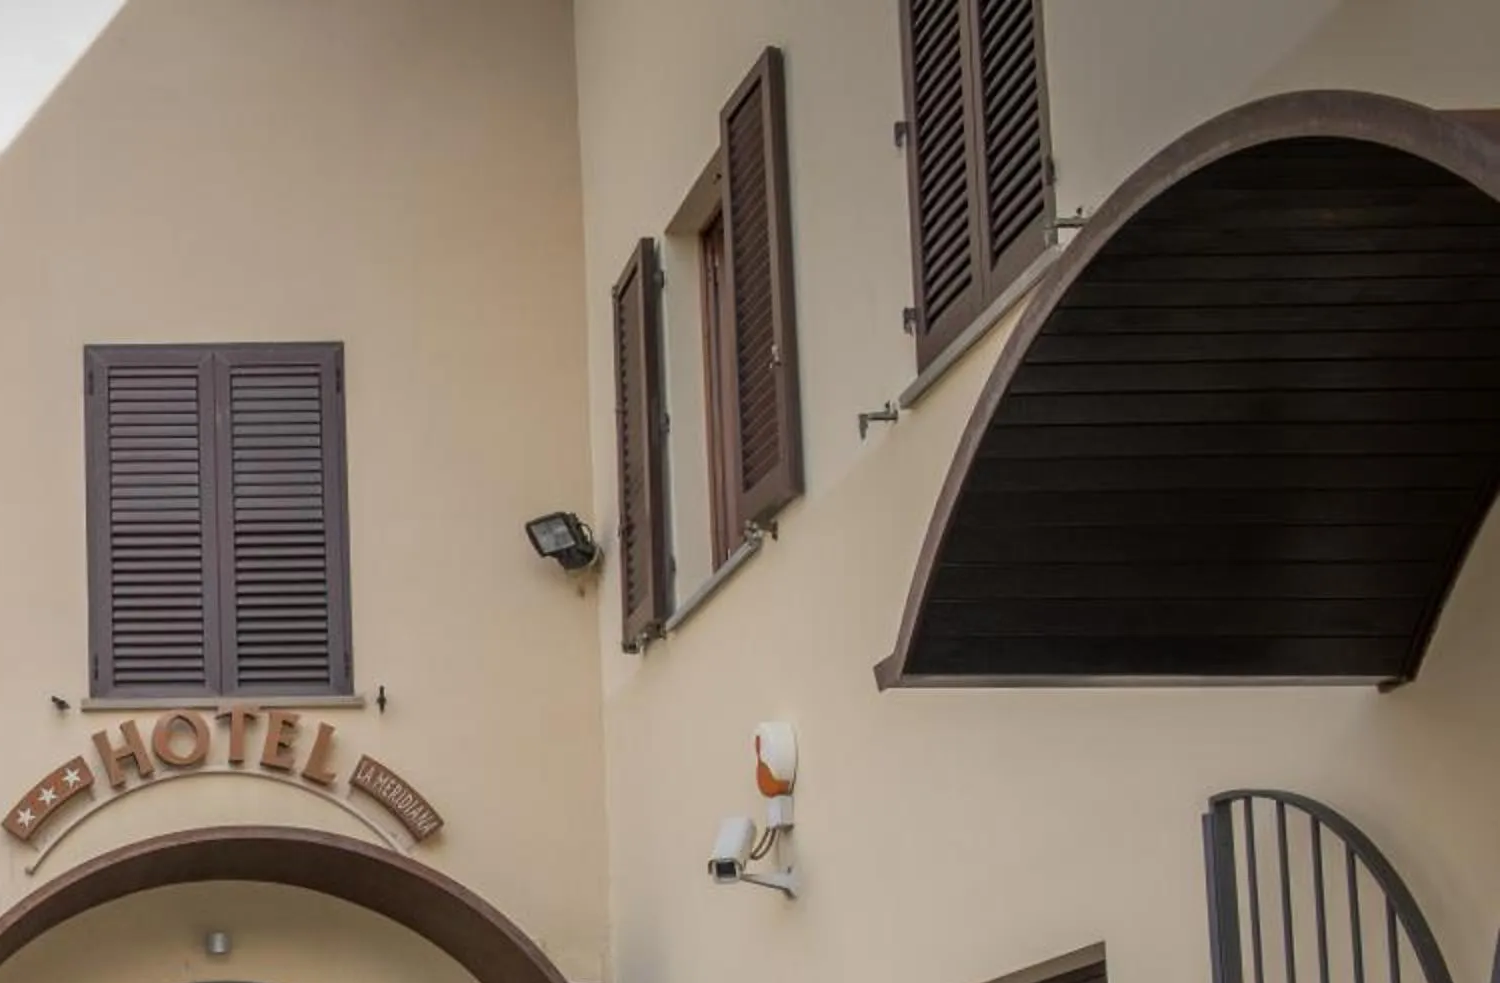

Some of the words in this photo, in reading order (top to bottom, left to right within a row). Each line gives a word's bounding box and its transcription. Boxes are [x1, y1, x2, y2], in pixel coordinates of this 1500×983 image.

[93, 706, 339, 788] HOTEL
[357, 760, 376, 784] LA
[373, 771, 438, 835] MERIDIANA
